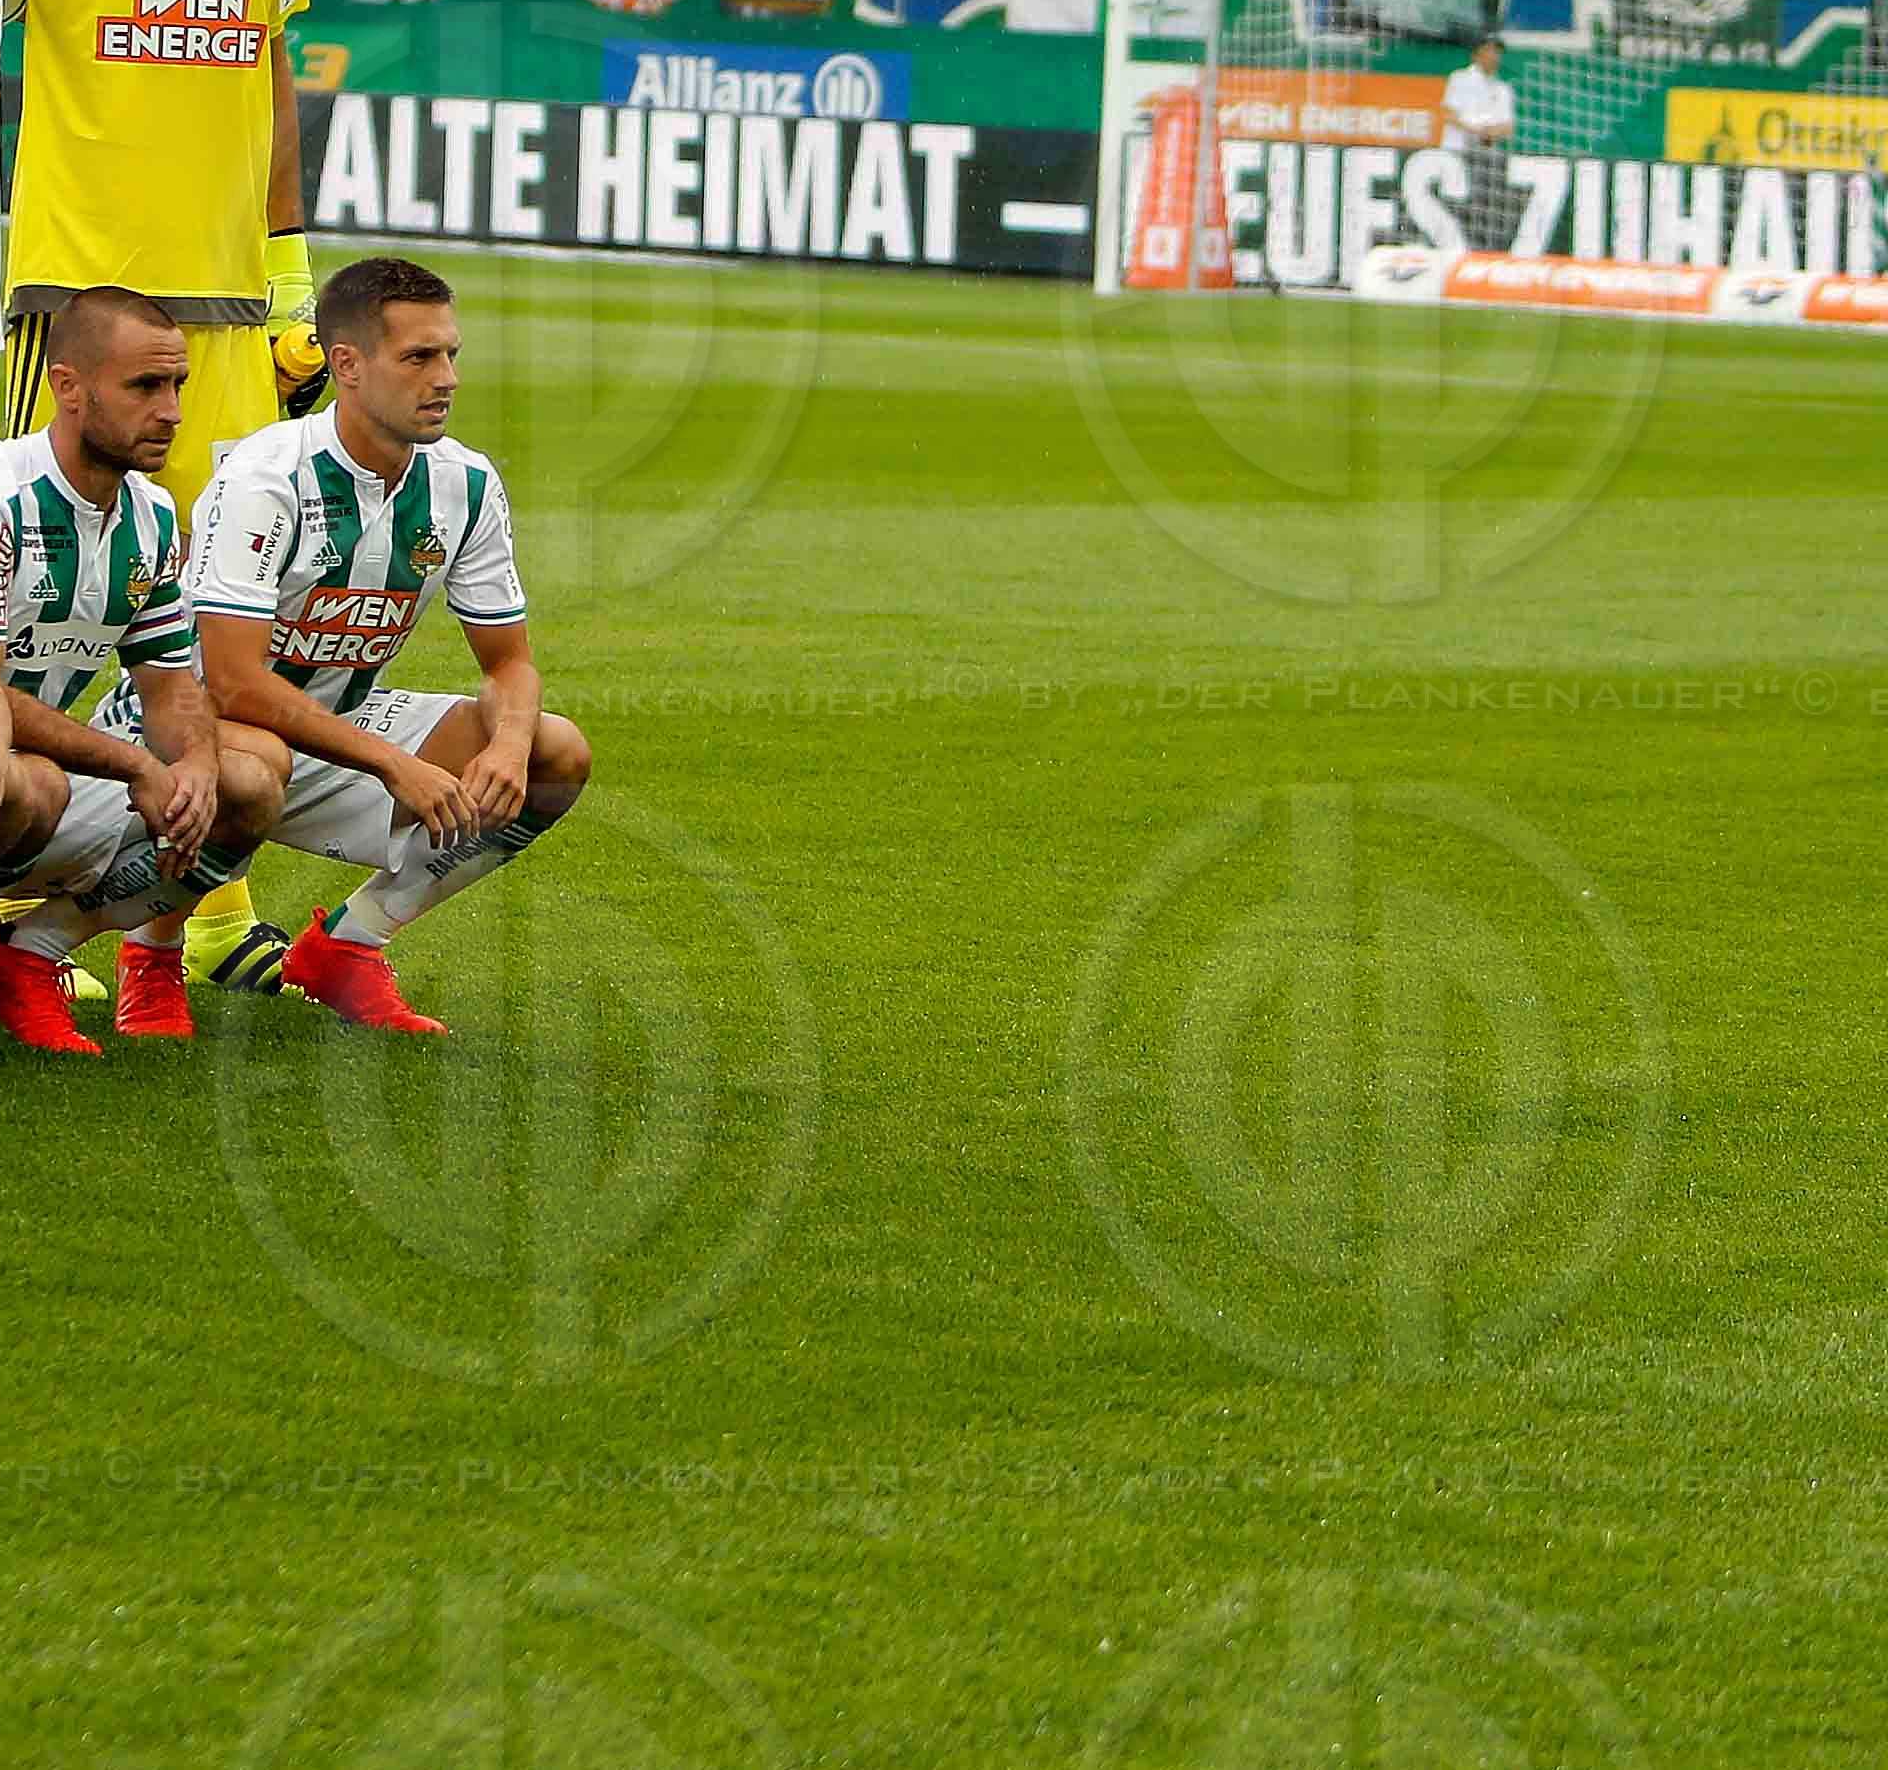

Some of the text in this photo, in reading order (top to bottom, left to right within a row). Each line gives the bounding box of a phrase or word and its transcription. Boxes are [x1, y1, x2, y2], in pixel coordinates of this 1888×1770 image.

[102, 23, 261, 64] ENERGIE
[626, 53, 804, 113] Allianz
[314, 93, 545, 238] ALTE
[577, 106, 977, 263] HEIMAT
[254, 511, 287, 583] WIENWERT
[308, 594, 412, 628] WIEN
[38, 637, 113, 659] LYONE
